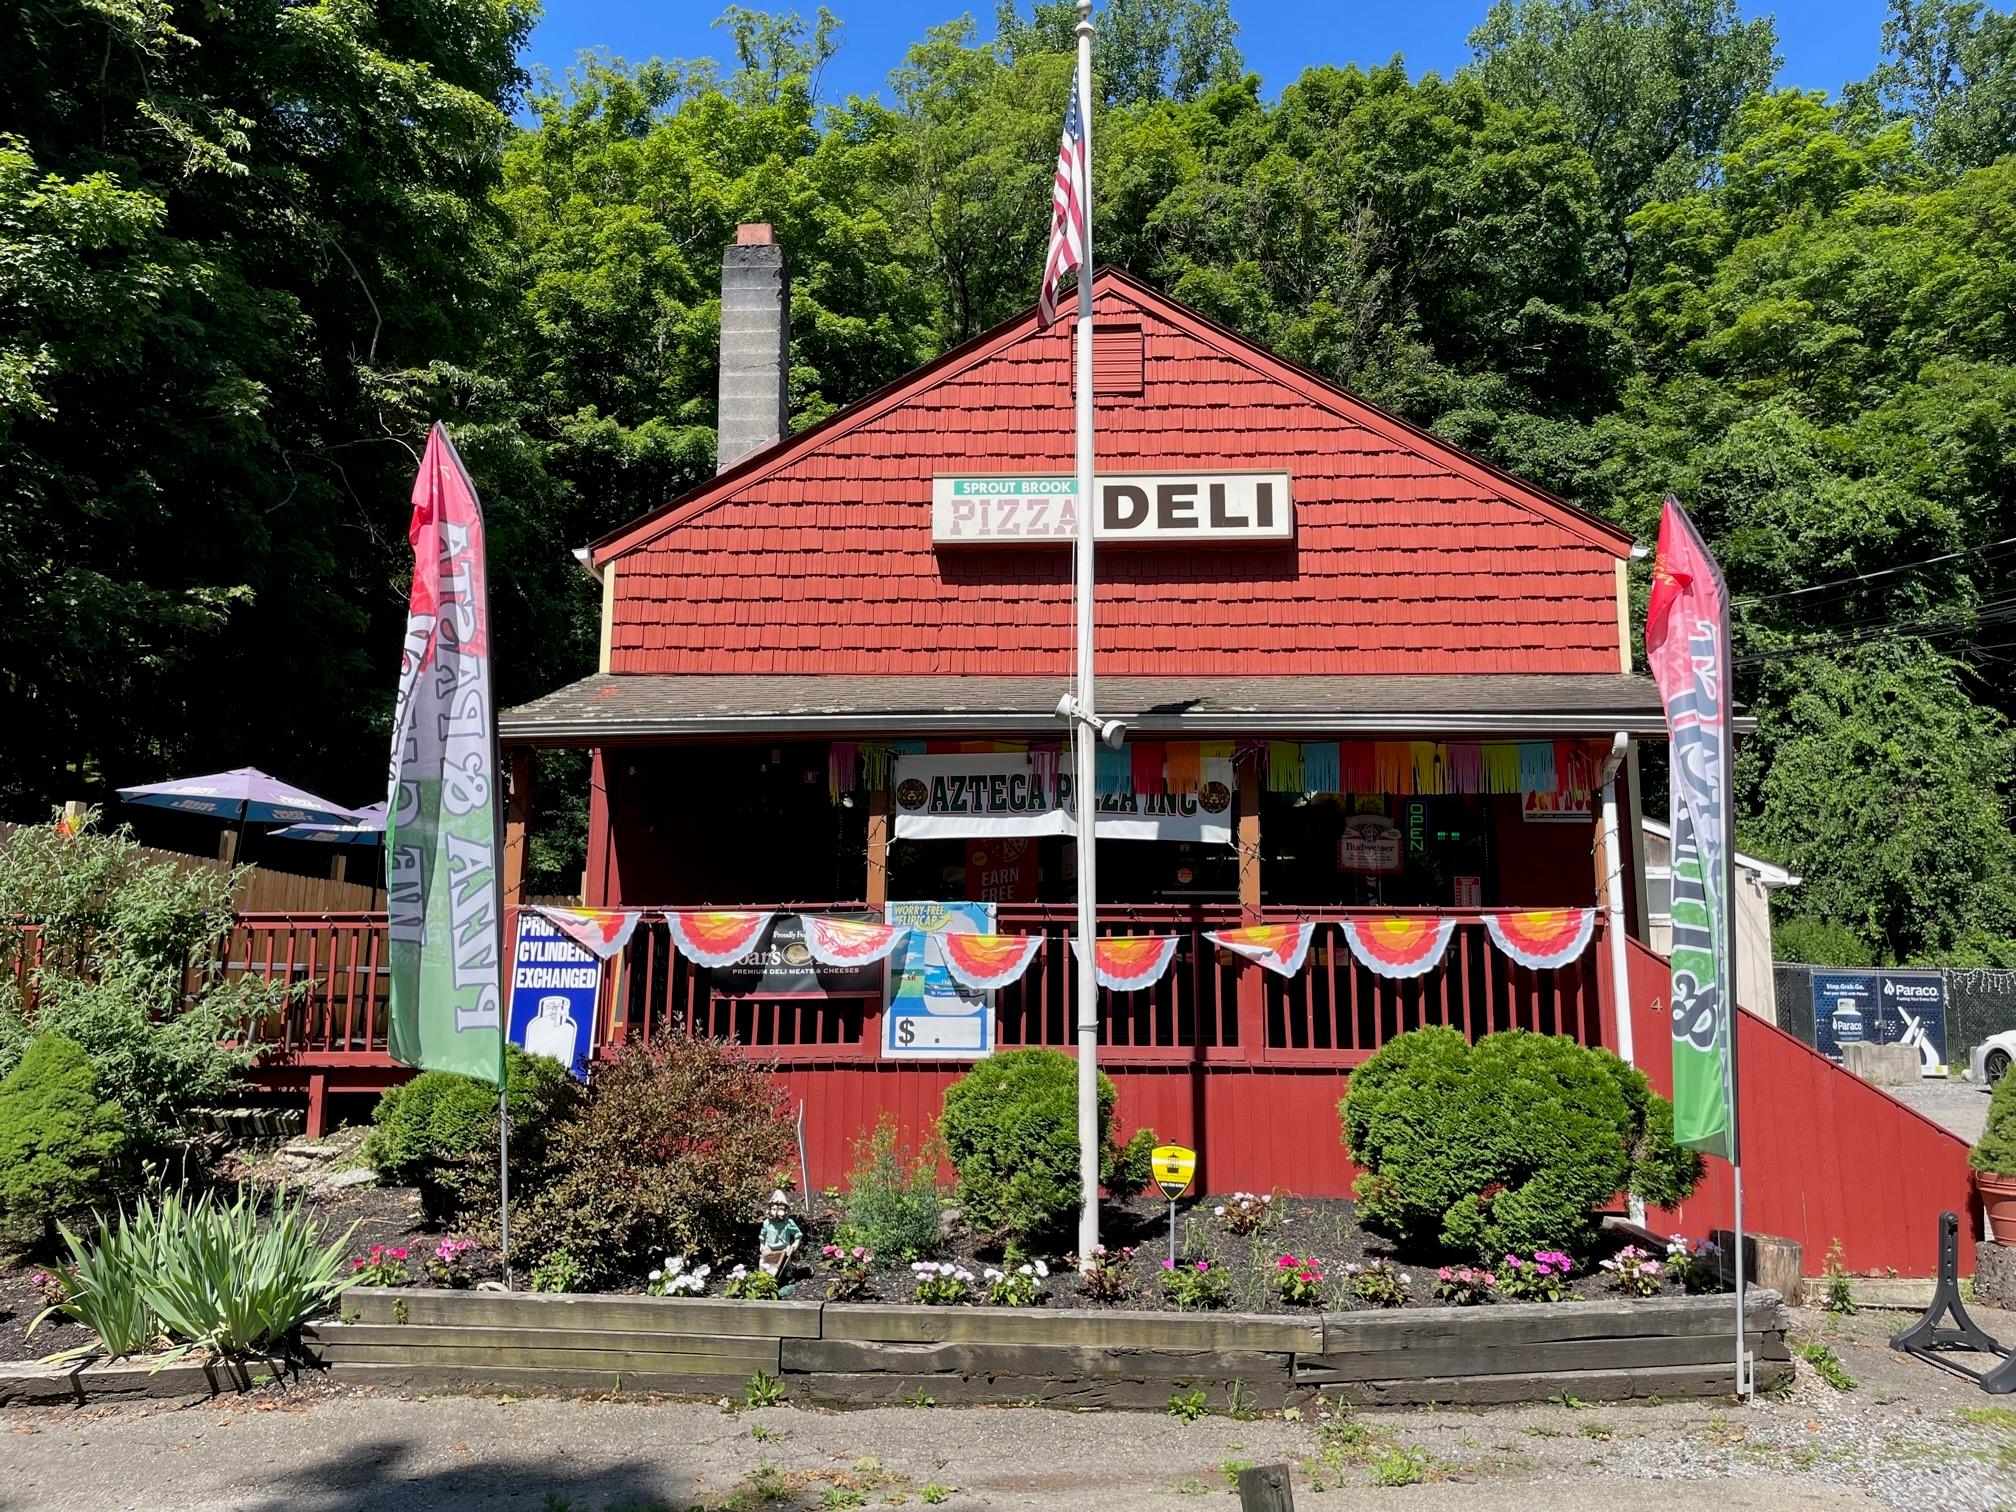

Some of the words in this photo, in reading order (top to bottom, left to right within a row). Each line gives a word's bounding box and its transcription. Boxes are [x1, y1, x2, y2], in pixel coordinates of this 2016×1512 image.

[962, 481, 1015, 494] SPROUT
[1021, 480, 1071, 493] BROOK
[1102, 482, 1273, 529] DELI
[950, 499, 1078, 536] PIZZA
[927, 773, 1046, 815] AZTECA
[1409, 802, 1425, 852] OPEN
[1345, 842, 1395, 852] Budweiser
[981, 867, 1019, 887] EARN
[981, 885, 1016, 902] FREE
[895, 903, 945, 916] WORRY-FREE
[898, 914, 917, 926] FLIP
[773, 930, 796, 940] Proudly
[515, 967, 597, 989] EXCHANGED
[732, 967, 768, 975] PREMIUM
[1650, 996, 1663, 1012] 4
[898, 1017, 916, 1046] $
[1837, 1021, 1862, 1031] Paraco
